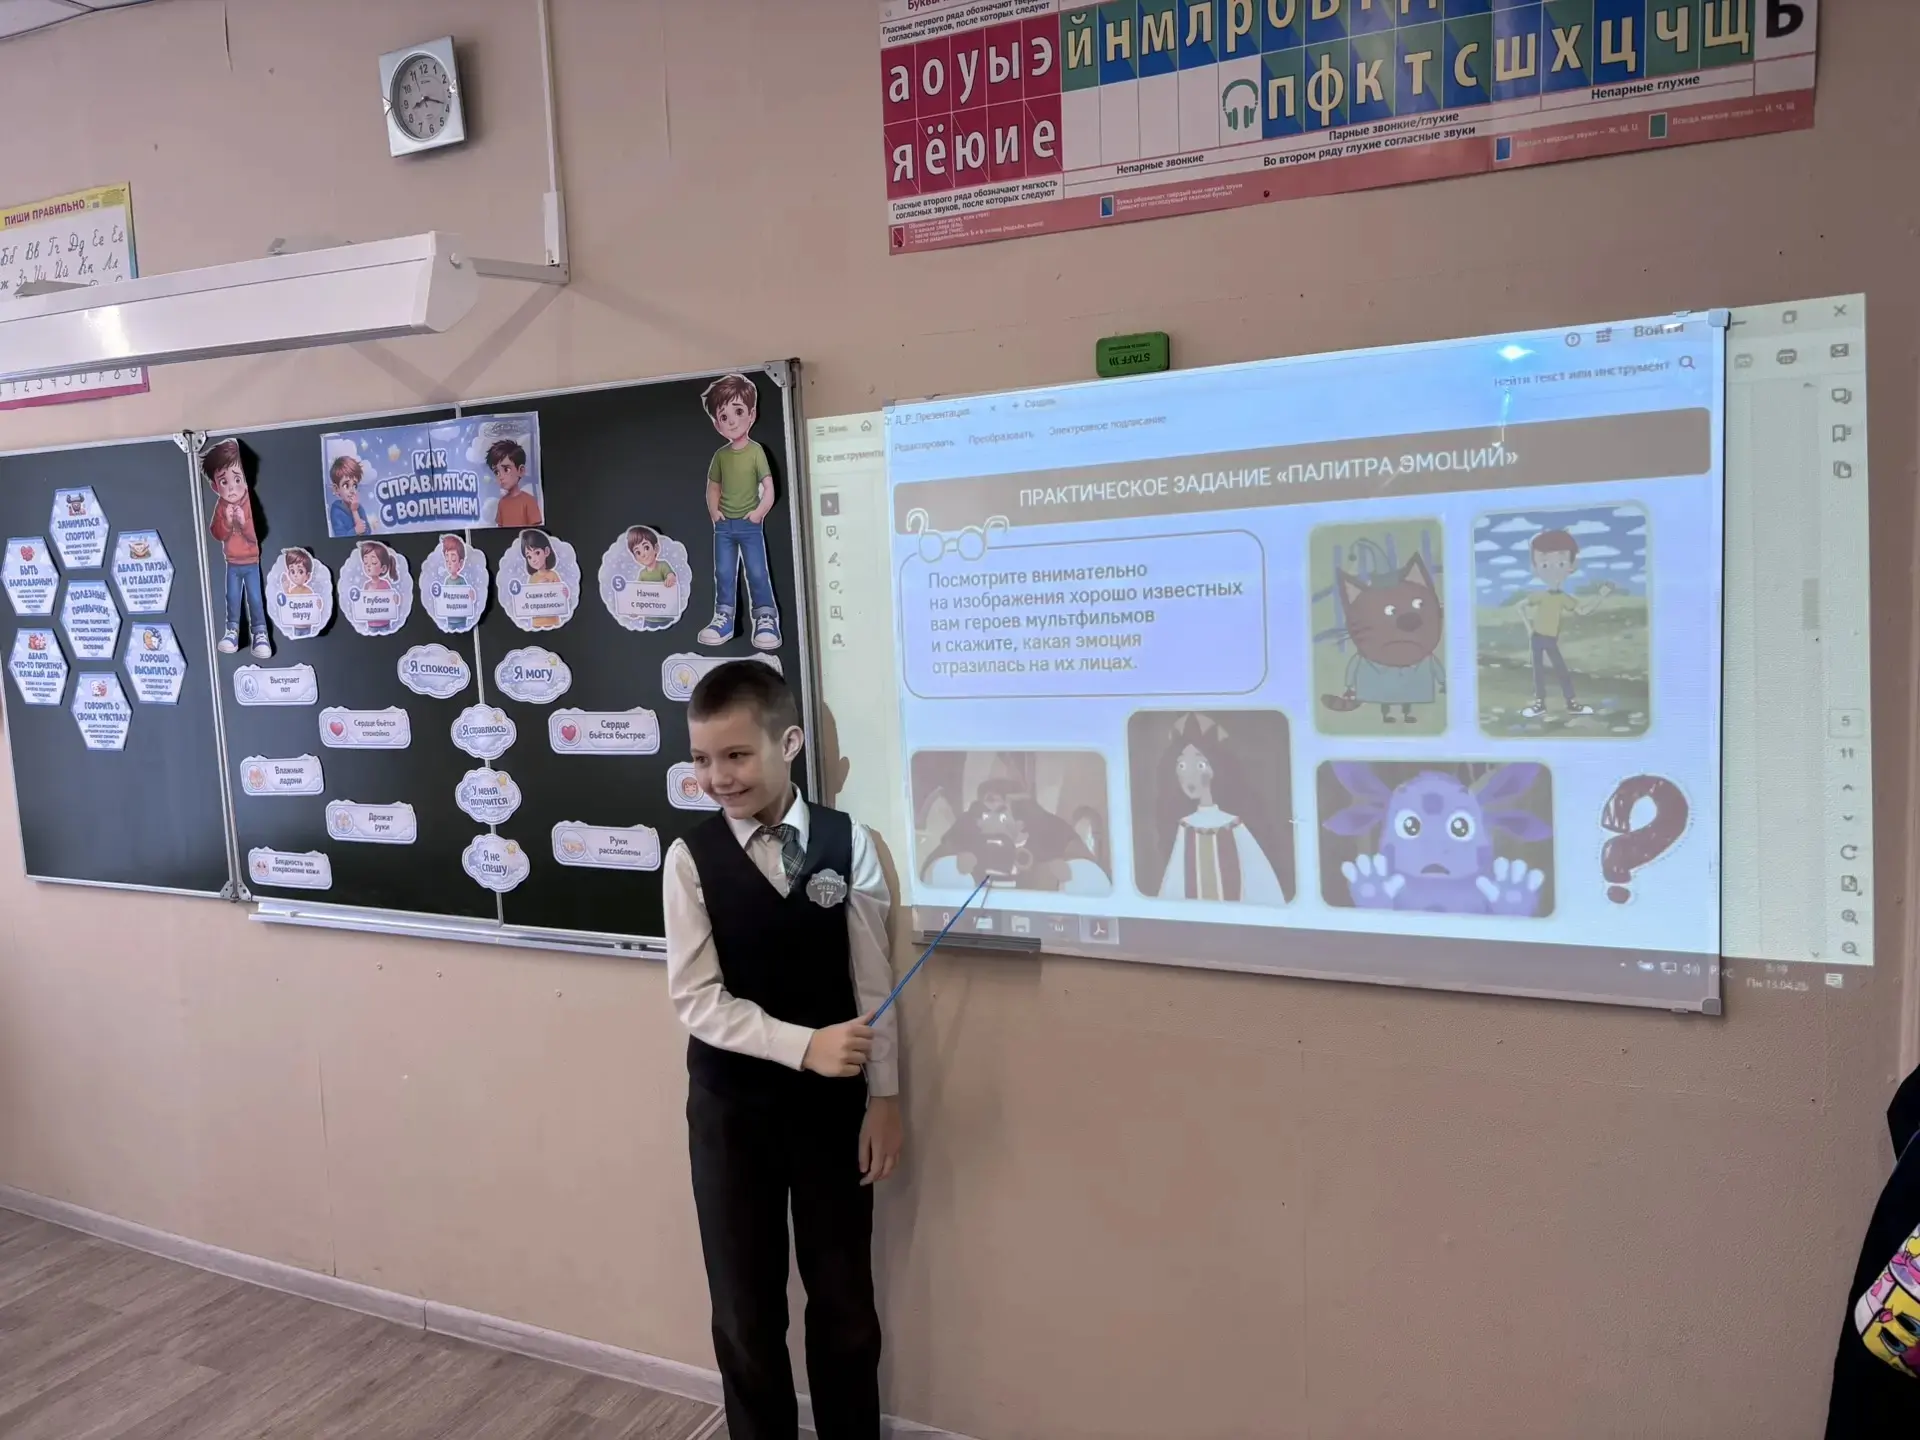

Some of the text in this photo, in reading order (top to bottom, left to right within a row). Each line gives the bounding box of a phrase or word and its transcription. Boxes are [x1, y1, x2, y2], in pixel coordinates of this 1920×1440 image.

[882, 22, 913, 36] Гласные
[914, 15, 944, 31] первого
[946, 11, 965, 24] ряда
[966, 2, 1013, 17] обозначают
[887, 29, 926, 43] согласных
[927, 23, 955, 36] звуков,
[956, 17, 978, 28] после
[980, 10, 1015, 24] которых
[1016, 2, 1050, 16] следуют
[1067, 13, 1092, 70] й
[1106, 19, 1131, 63] н
[1141, 10, 1176, 55] м
[1185, 2, 1212, 47] л
[419, 64, 429, 74] 12
[1268, 0, 1750, 127] п ф к т с ш х ц ч щ
[889, 36, 1053, 104] а о у ы э
[1591, 74, 1701, 101] Непарные глухие
[1328, 111, 1459, 142] Парные звонкие/глухие
[892, 120, 1056, 183] я ё ю и е
[1263, 126, 1476, 168] Во втором ряду глухие согласные звуки
[1116, 154, 1205, 175] Непарные звонкие
[892, 180, 1058, 213] Гласные второго ряда обозначают мягкость
[895, 189, 1056, 220] согласных звуков, после которых следуют
[5, 212, 30, 226] ПИШИ
[32, 199, 85, 220] ПРАВИЛЬНО
[415, 449, 447, 471] КАК
[1019, 442, 1519, 507] ПРАКТИЧЕСКОЕ ЗАДАНИЕ «ПАЛИТРА ЭМОЦИЙ»
[377, 471, 477, 500] СПРАВЛЯТЬСЯ
[382, 497, 478, 523] С ВОЛНЕНИЕМ
[57, 517, 100, 529] ЗАНИМАТЬСЯ
[65, 531, 95, 541] СПОРТОМ
[20, 565, 38, 576] БЫТЬ
[118, 561, 168, 573] ДЕЛАТЬ ПАУЗЫ
[129, 575, 166, 585] ОТДЫХАТЬ
[615, 578, 622, 589] 5
[928, 562, 1148, 593] Посмотрите внимательно
[512, 583, 519, 592] 4
[71, 589, 106, 601] ПОЛЕЗНЫЕ
[363, 595, 390, 605] Глубоко
[929, 580, 1243, 613] на изображения хорошо известных
[289, 599, 313, 611] Сделай
[366, 606, 389, 615] вдохни
[636, 602, 666, 610] простого
[292, 611, 311, 621] паузу
[930, 609, 1155, 635] вам героев мультфильмов
[931, 631, 1142, 655] и скажите, какая эмоция
[140, 653, 169, 663] ХОРОШО
[135, 665, 177, 676] ВЫСЫПАТЬСЯ
[410, 660, 460, 675] Я спокоен
[931, 656, 1138, 678] отразилась на их лицах.
[514, 666, 553, 682] Я могу
[270, 676, 300, 686] Выступает
[84, 701, 114, 710] ГОВОРИТЬ
[354, 719, 396, 728] Сердце бьётся
[600, 719, 630, 730] Сердце
[362, 729, 390, 737] спокойно
[462, 725, 506, 735] Я справлюсь
[589, 730, 646, 740] бьётся быстрее
[274, 766, 304, 775] Влажные
[279, 776, 302, 786] ладони
[472, 786, 498, 797] У меня
[470, 796, 508, 807] получится
[368, 812, 393, 822] Дрожат
[374, 824, 390, 832] руки
[609, 836, 628, 846] Руки
[483, 851, 500, 862] Я не
[598, 846, 641, 857] расслаблены
[482, 863, 507, 876] спешу
[820, 891, 834, 904] 17
